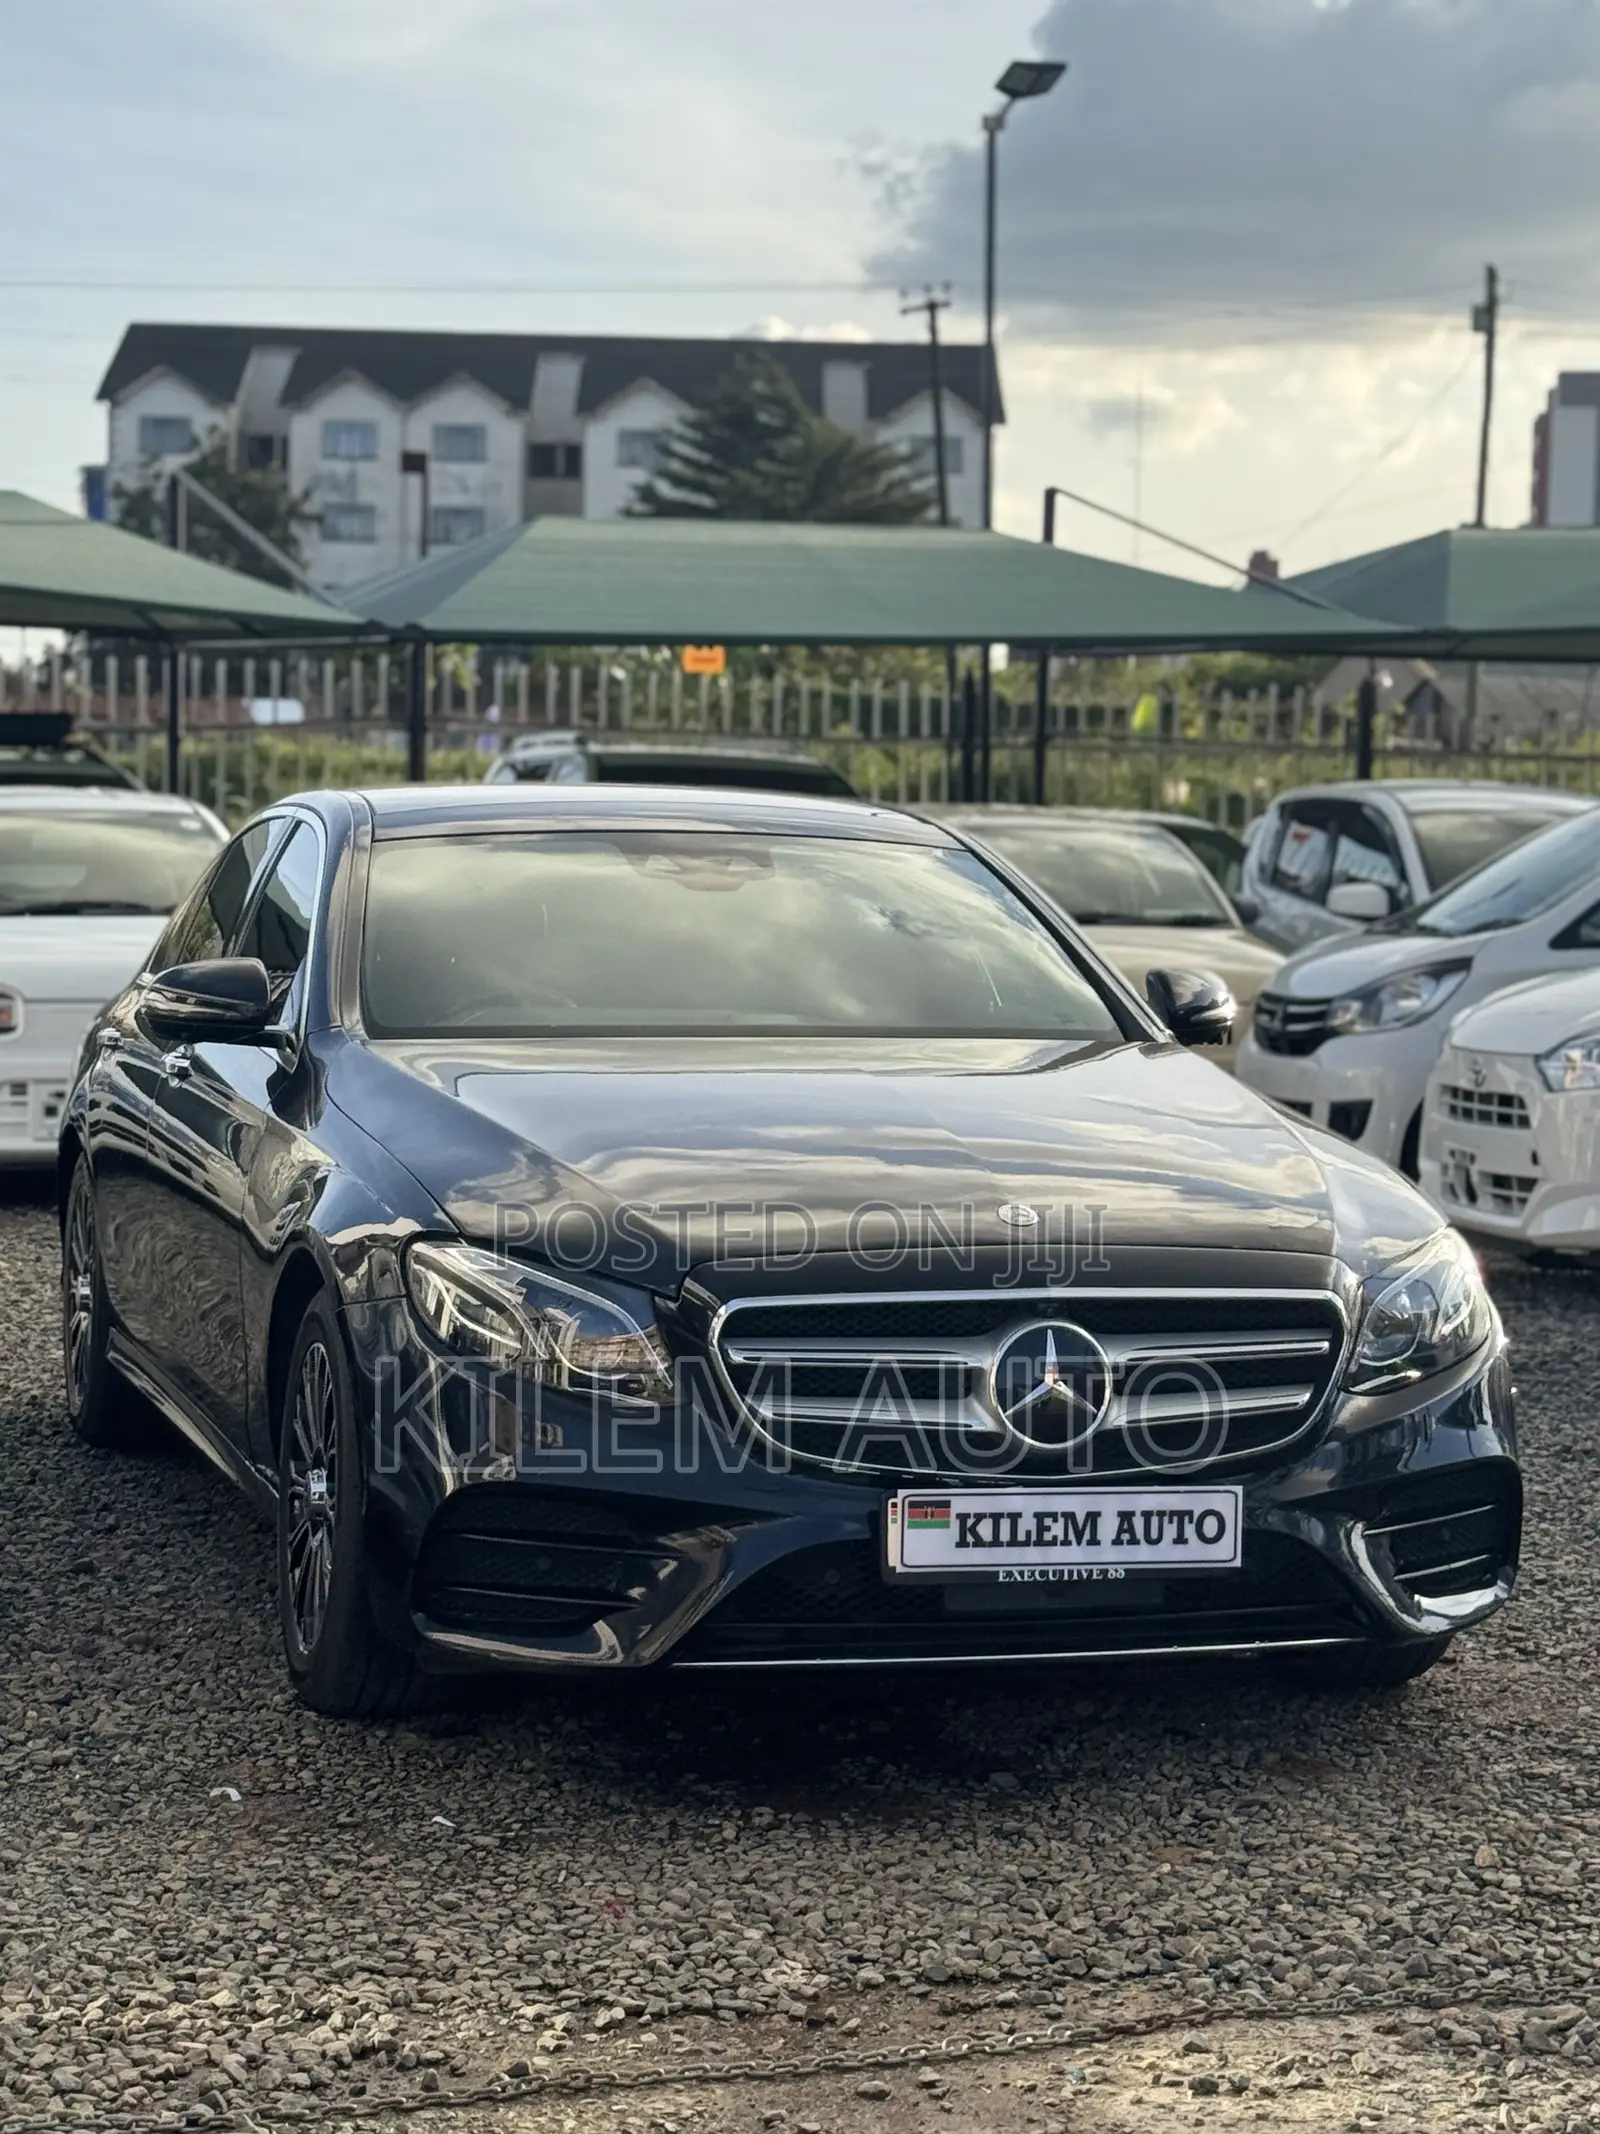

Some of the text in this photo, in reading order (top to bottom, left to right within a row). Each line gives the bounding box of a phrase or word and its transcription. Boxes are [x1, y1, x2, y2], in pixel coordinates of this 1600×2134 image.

[955, 1508, 1226, 1548] KILEM AUTO
[998, 1567, 1103, 1582] EXECUTIVE
